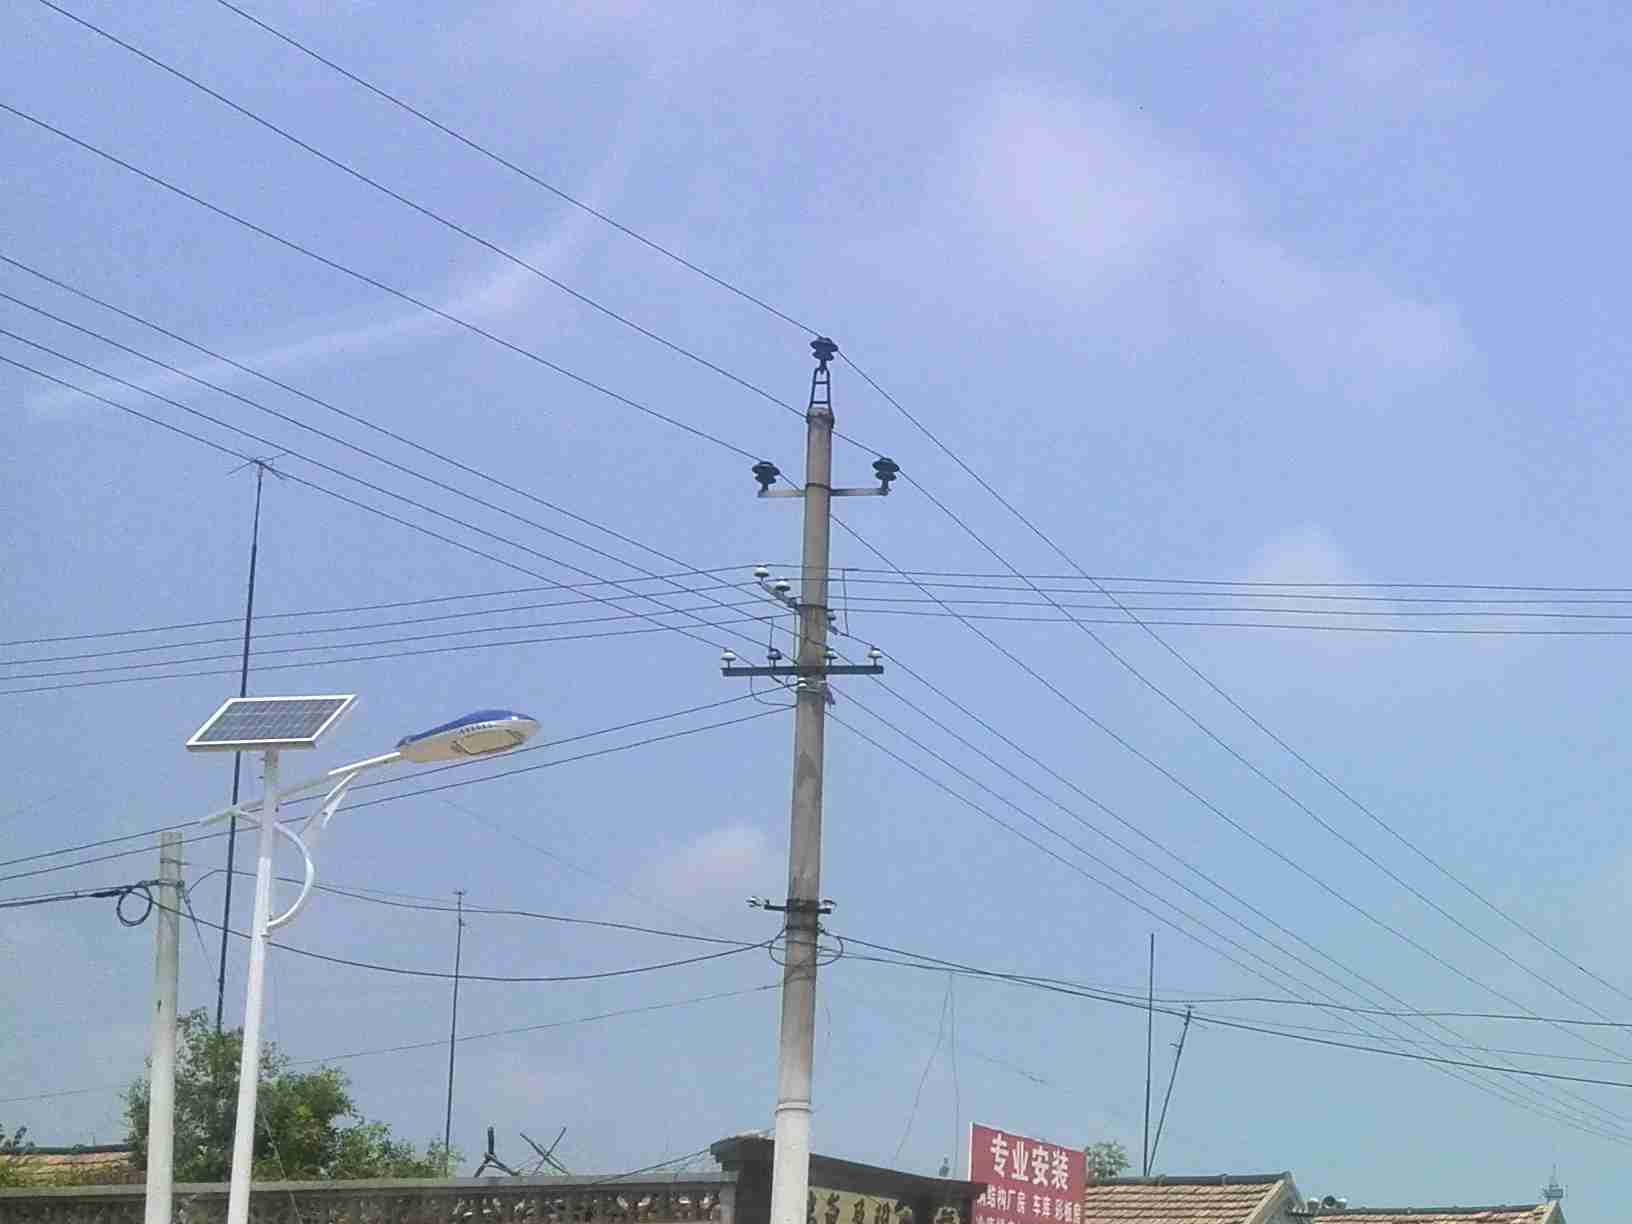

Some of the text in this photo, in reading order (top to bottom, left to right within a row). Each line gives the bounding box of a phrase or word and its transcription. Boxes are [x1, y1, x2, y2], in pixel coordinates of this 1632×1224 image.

[990, 1133, 1070, 1192] 专业安装
[1032, 1194, 1051, 1217] 车库
